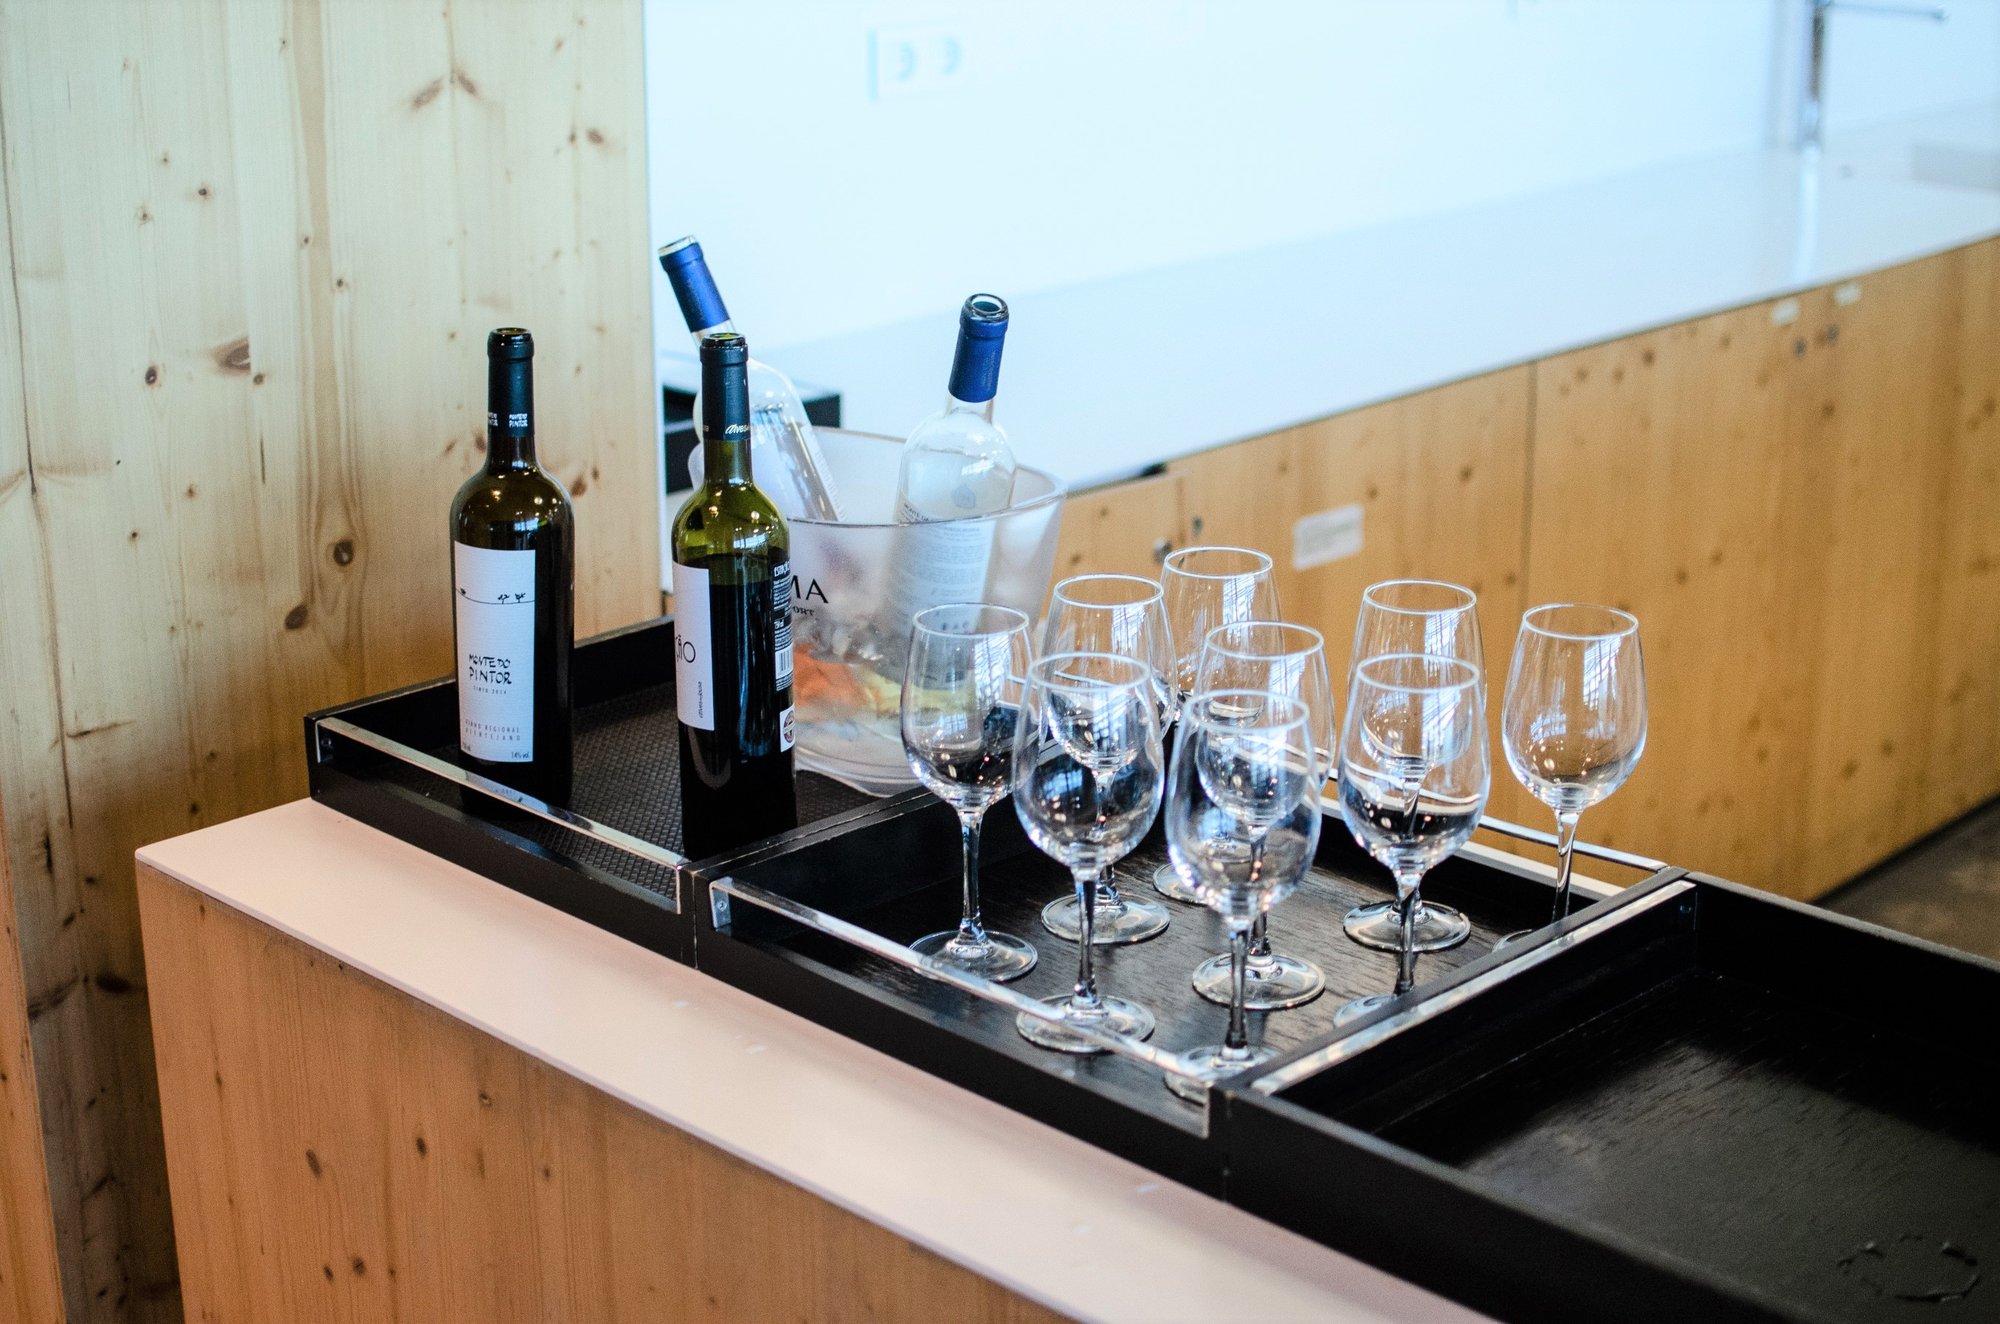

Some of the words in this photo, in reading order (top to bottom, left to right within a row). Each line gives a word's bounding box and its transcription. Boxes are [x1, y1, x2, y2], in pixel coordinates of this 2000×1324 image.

[469, 653, 496, 668] MONTE
[497, 659, 511, 669] DO
[469, 666, 512, 685] PINTOR
